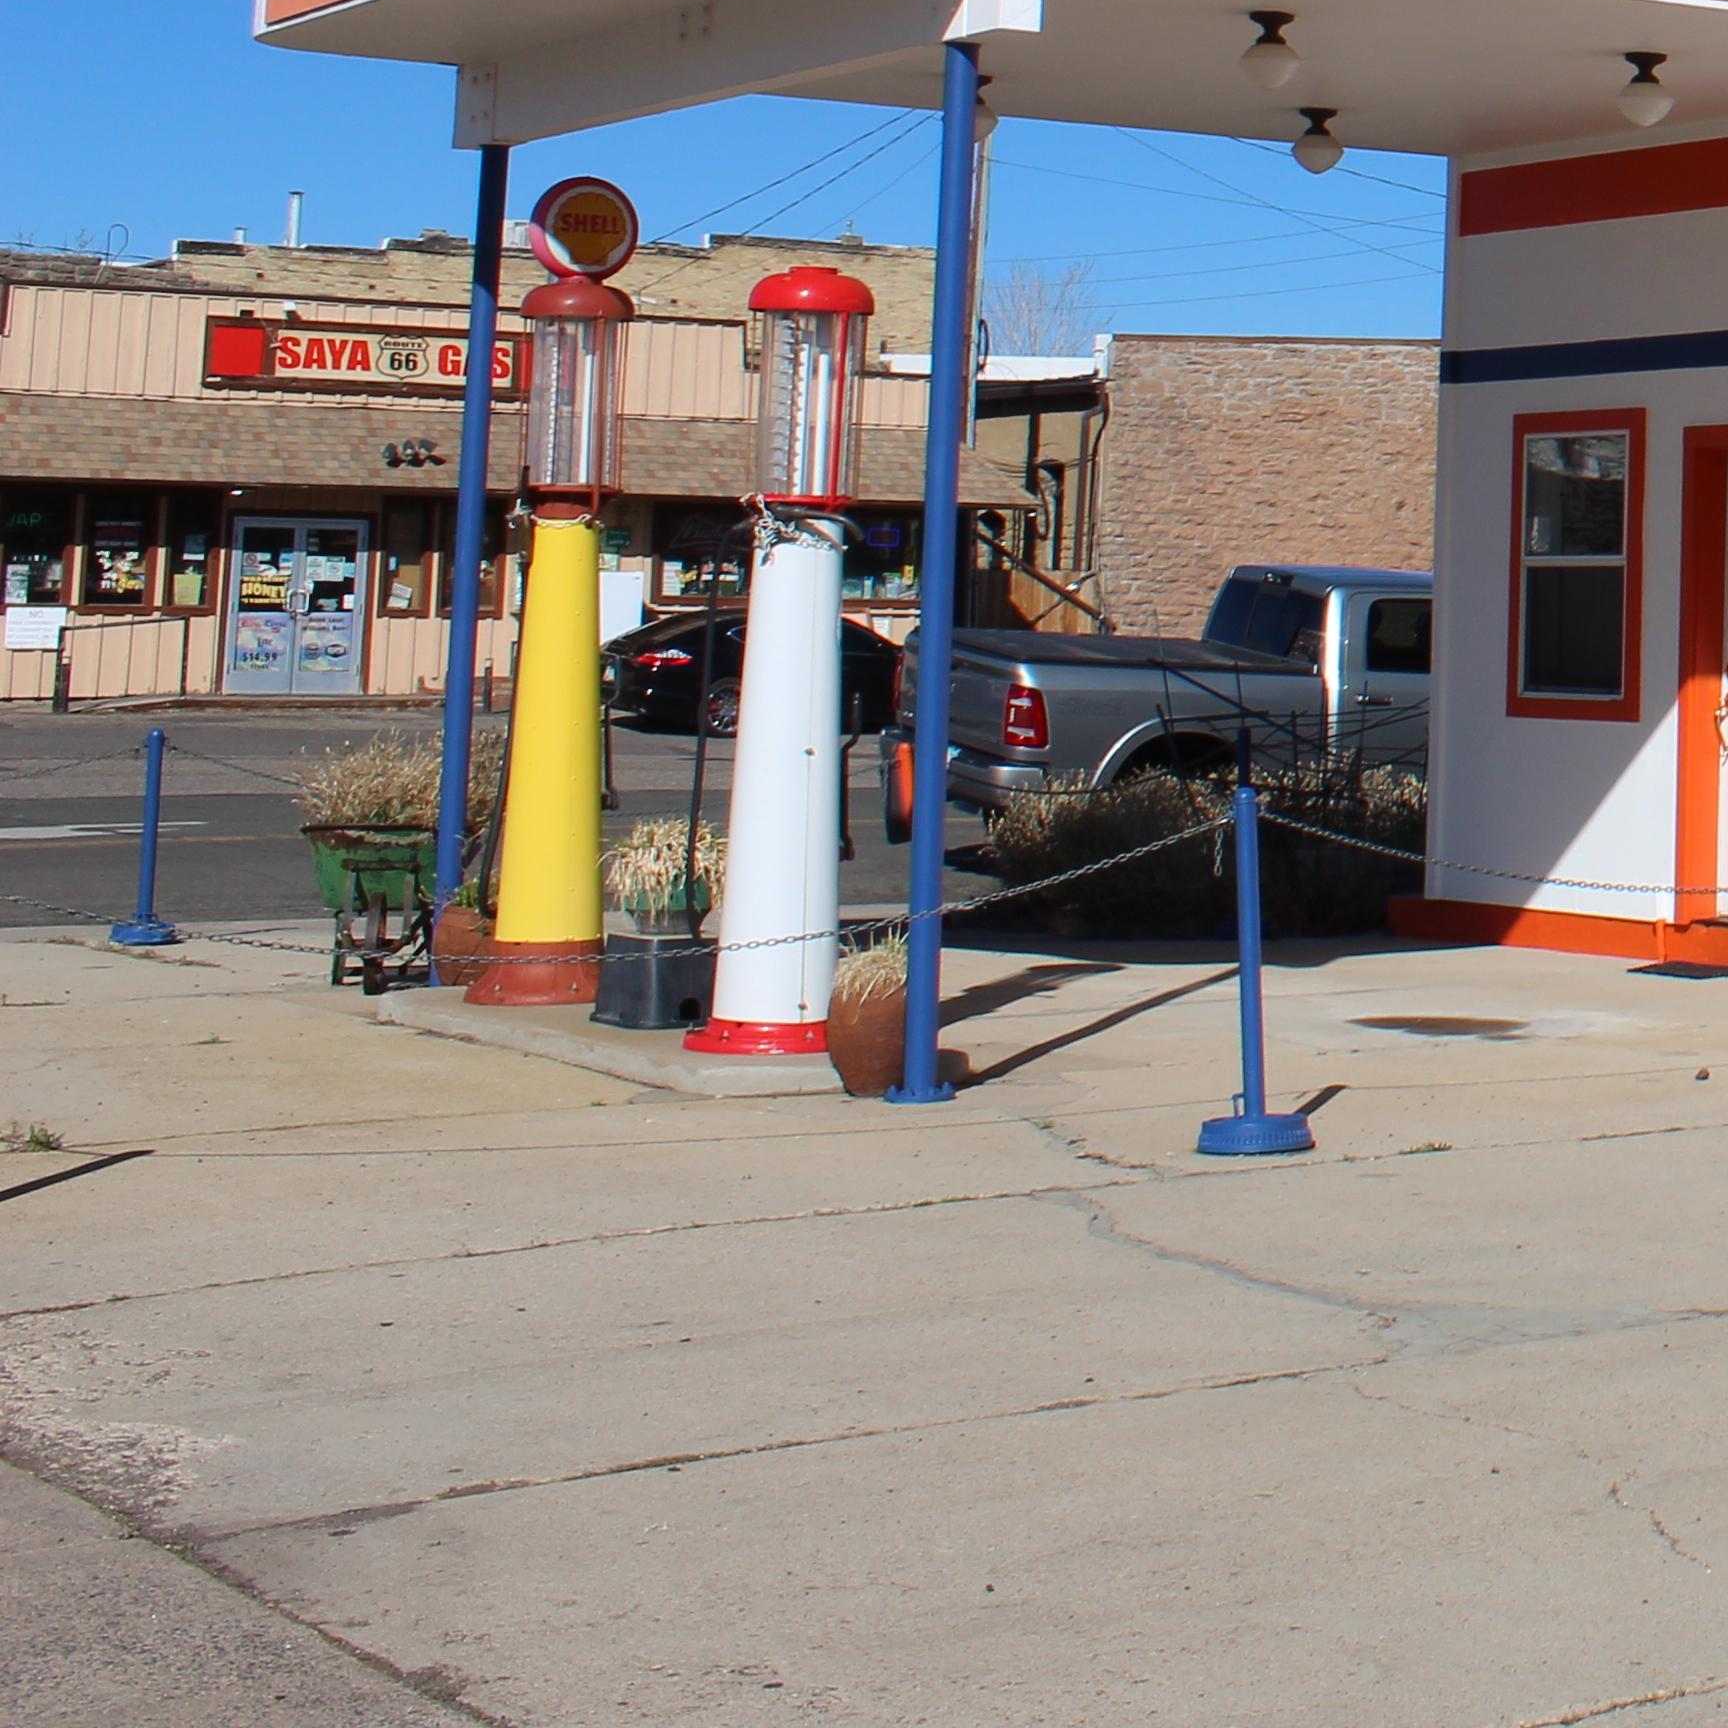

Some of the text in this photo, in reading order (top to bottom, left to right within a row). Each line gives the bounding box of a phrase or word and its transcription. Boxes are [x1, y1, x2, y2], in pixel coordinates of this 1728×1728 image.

[560, 212, 621, 236] SHELL
[383, 340, 423, 349] ROUTE
[278, 336, 371, 372] SAYA
[390, 352, 418, 372] 66
[242, 582, 288, 598] HONEY
[243, 651, 278, 663] $14.99
